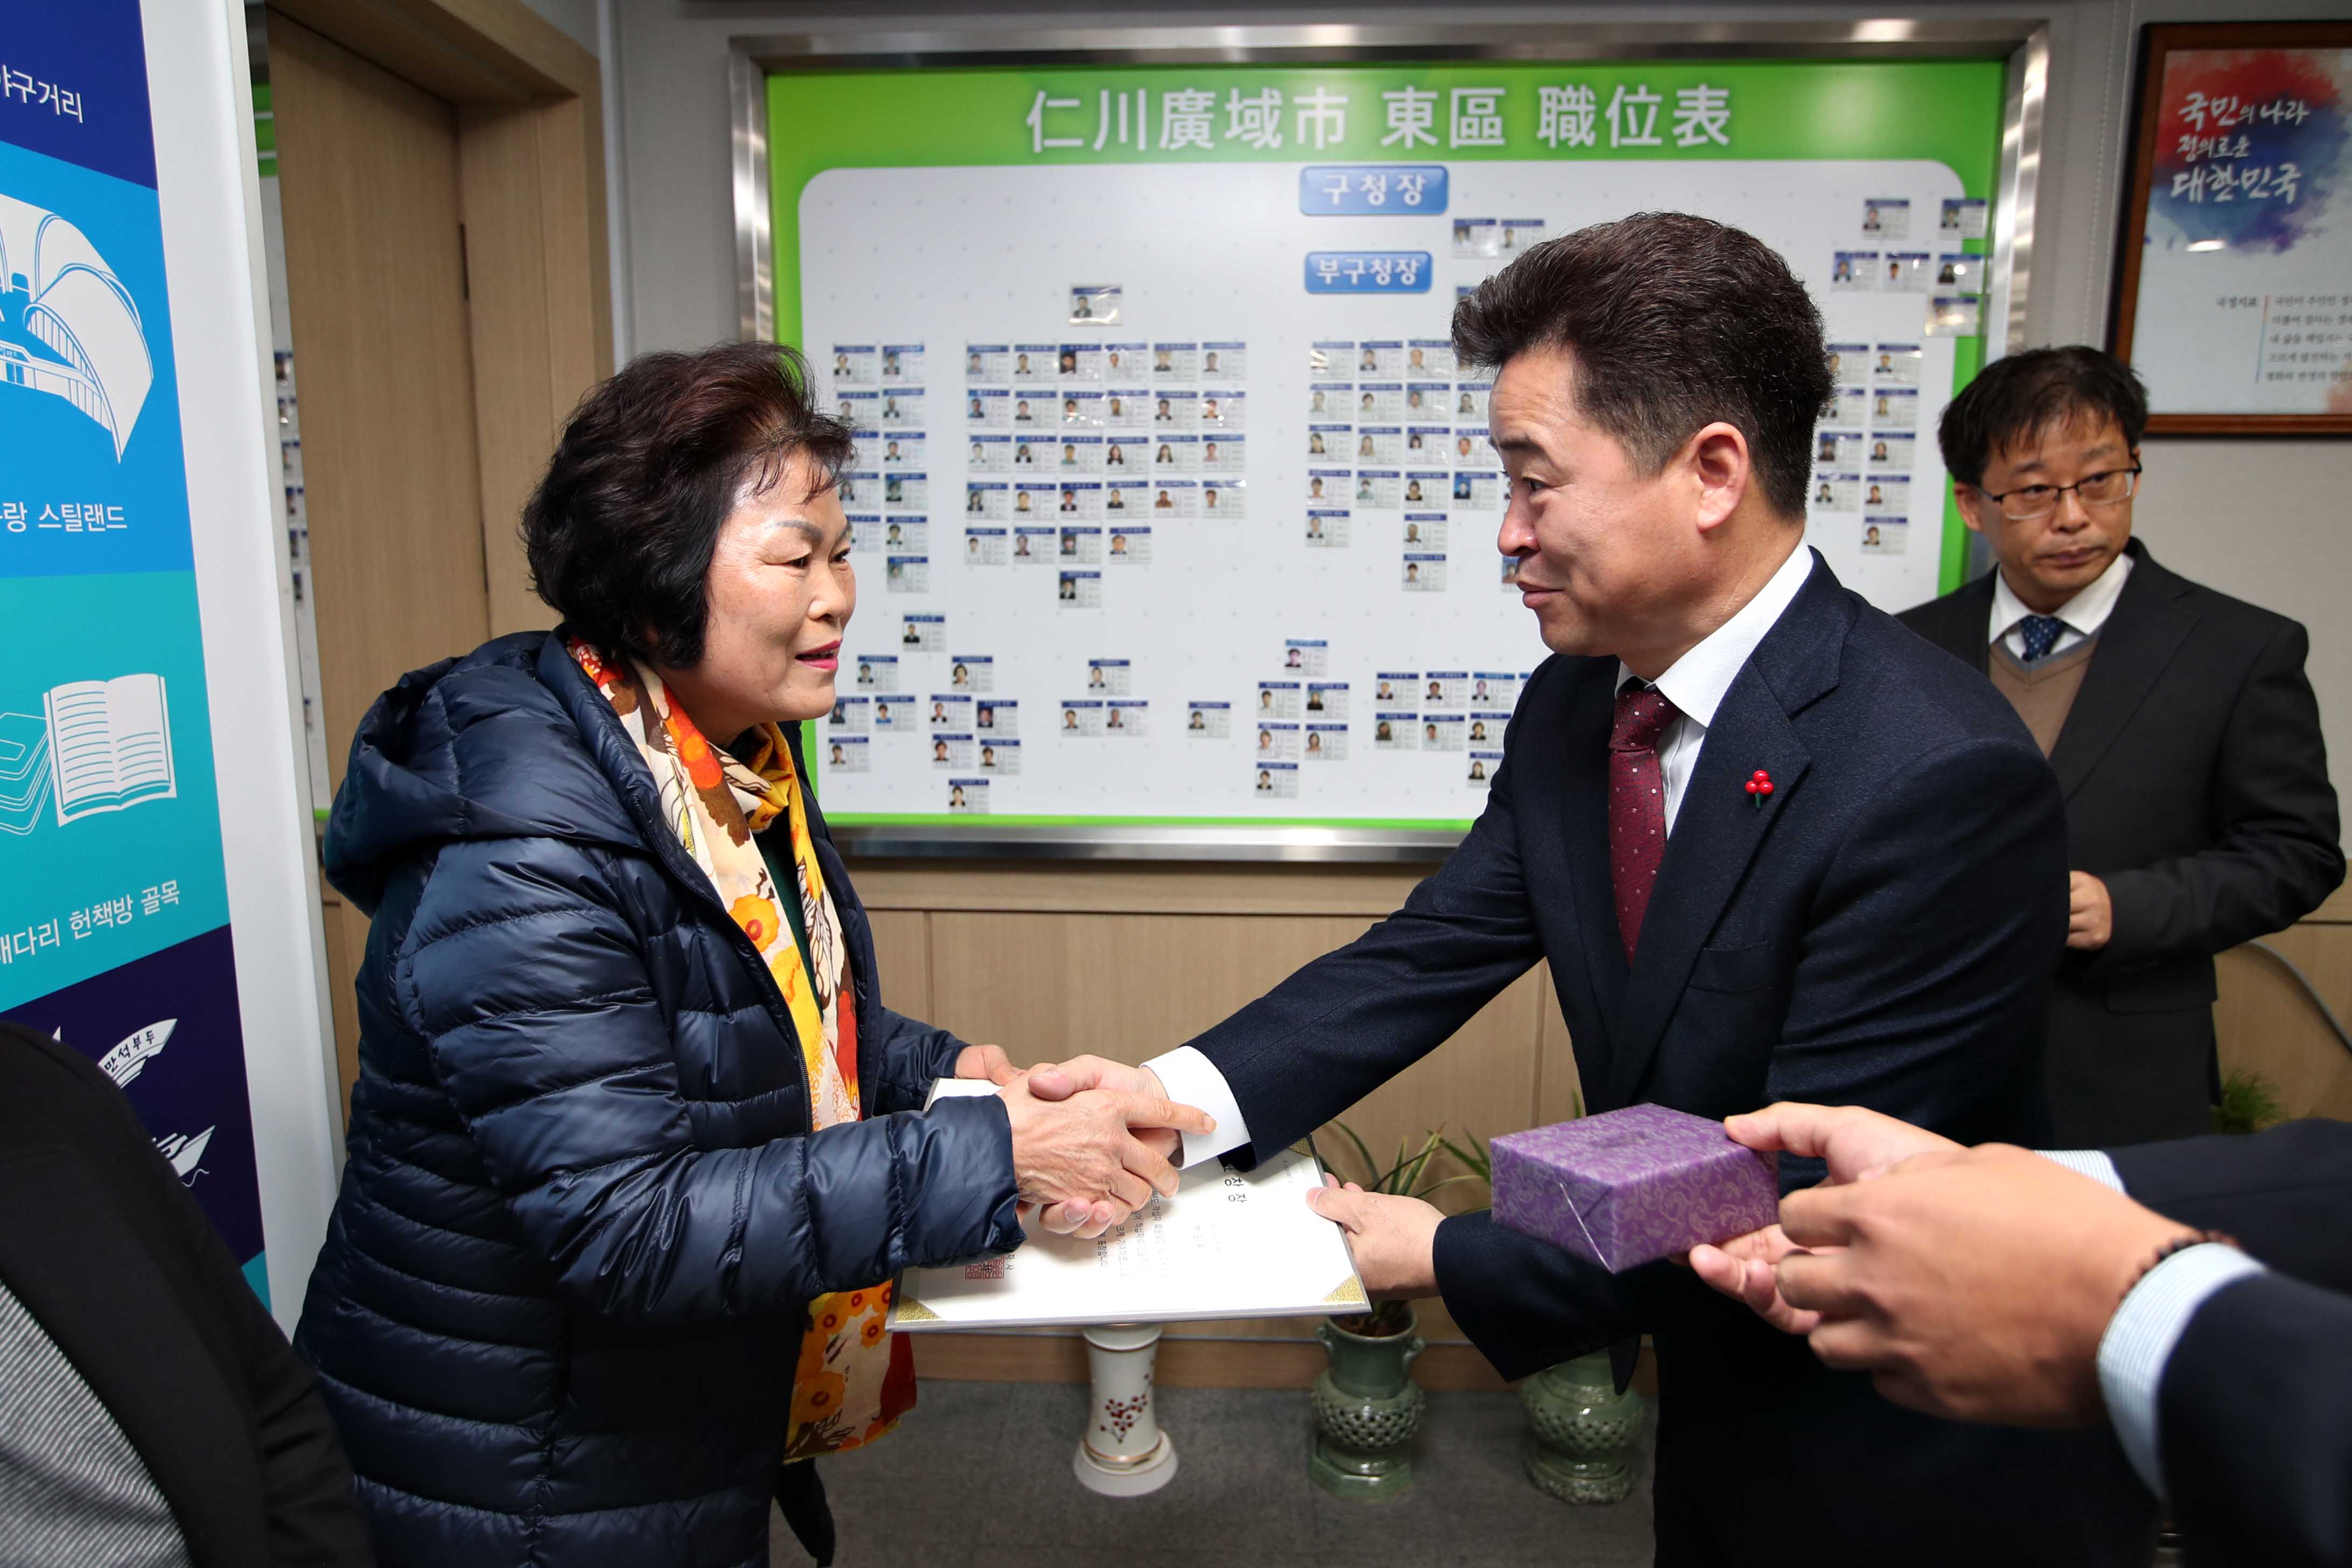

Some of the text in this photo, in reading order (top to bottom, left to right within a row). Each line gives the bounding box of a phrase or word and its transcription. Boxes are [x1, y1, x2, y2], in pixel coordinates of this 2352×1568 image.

[1026, 84, 1731, 153] 仁川廣域市 東區 職位表
[2178, 92, 2309, 132] 국민의 나라
[2176, 135, 2250, 162] 정의로운
[1322, 173, 1426, 206] 구청장
[2170, 162, 2302, 204] 대한민국
[1316, 258, 1420, 285] 부구청장
[38, 503, 128, 533] 스틸랜드
[69, 894, 134, 940] 헌책방
[141, 879, 180, 915] 골목
[104, 1030, 155, 1073] 만석부두
